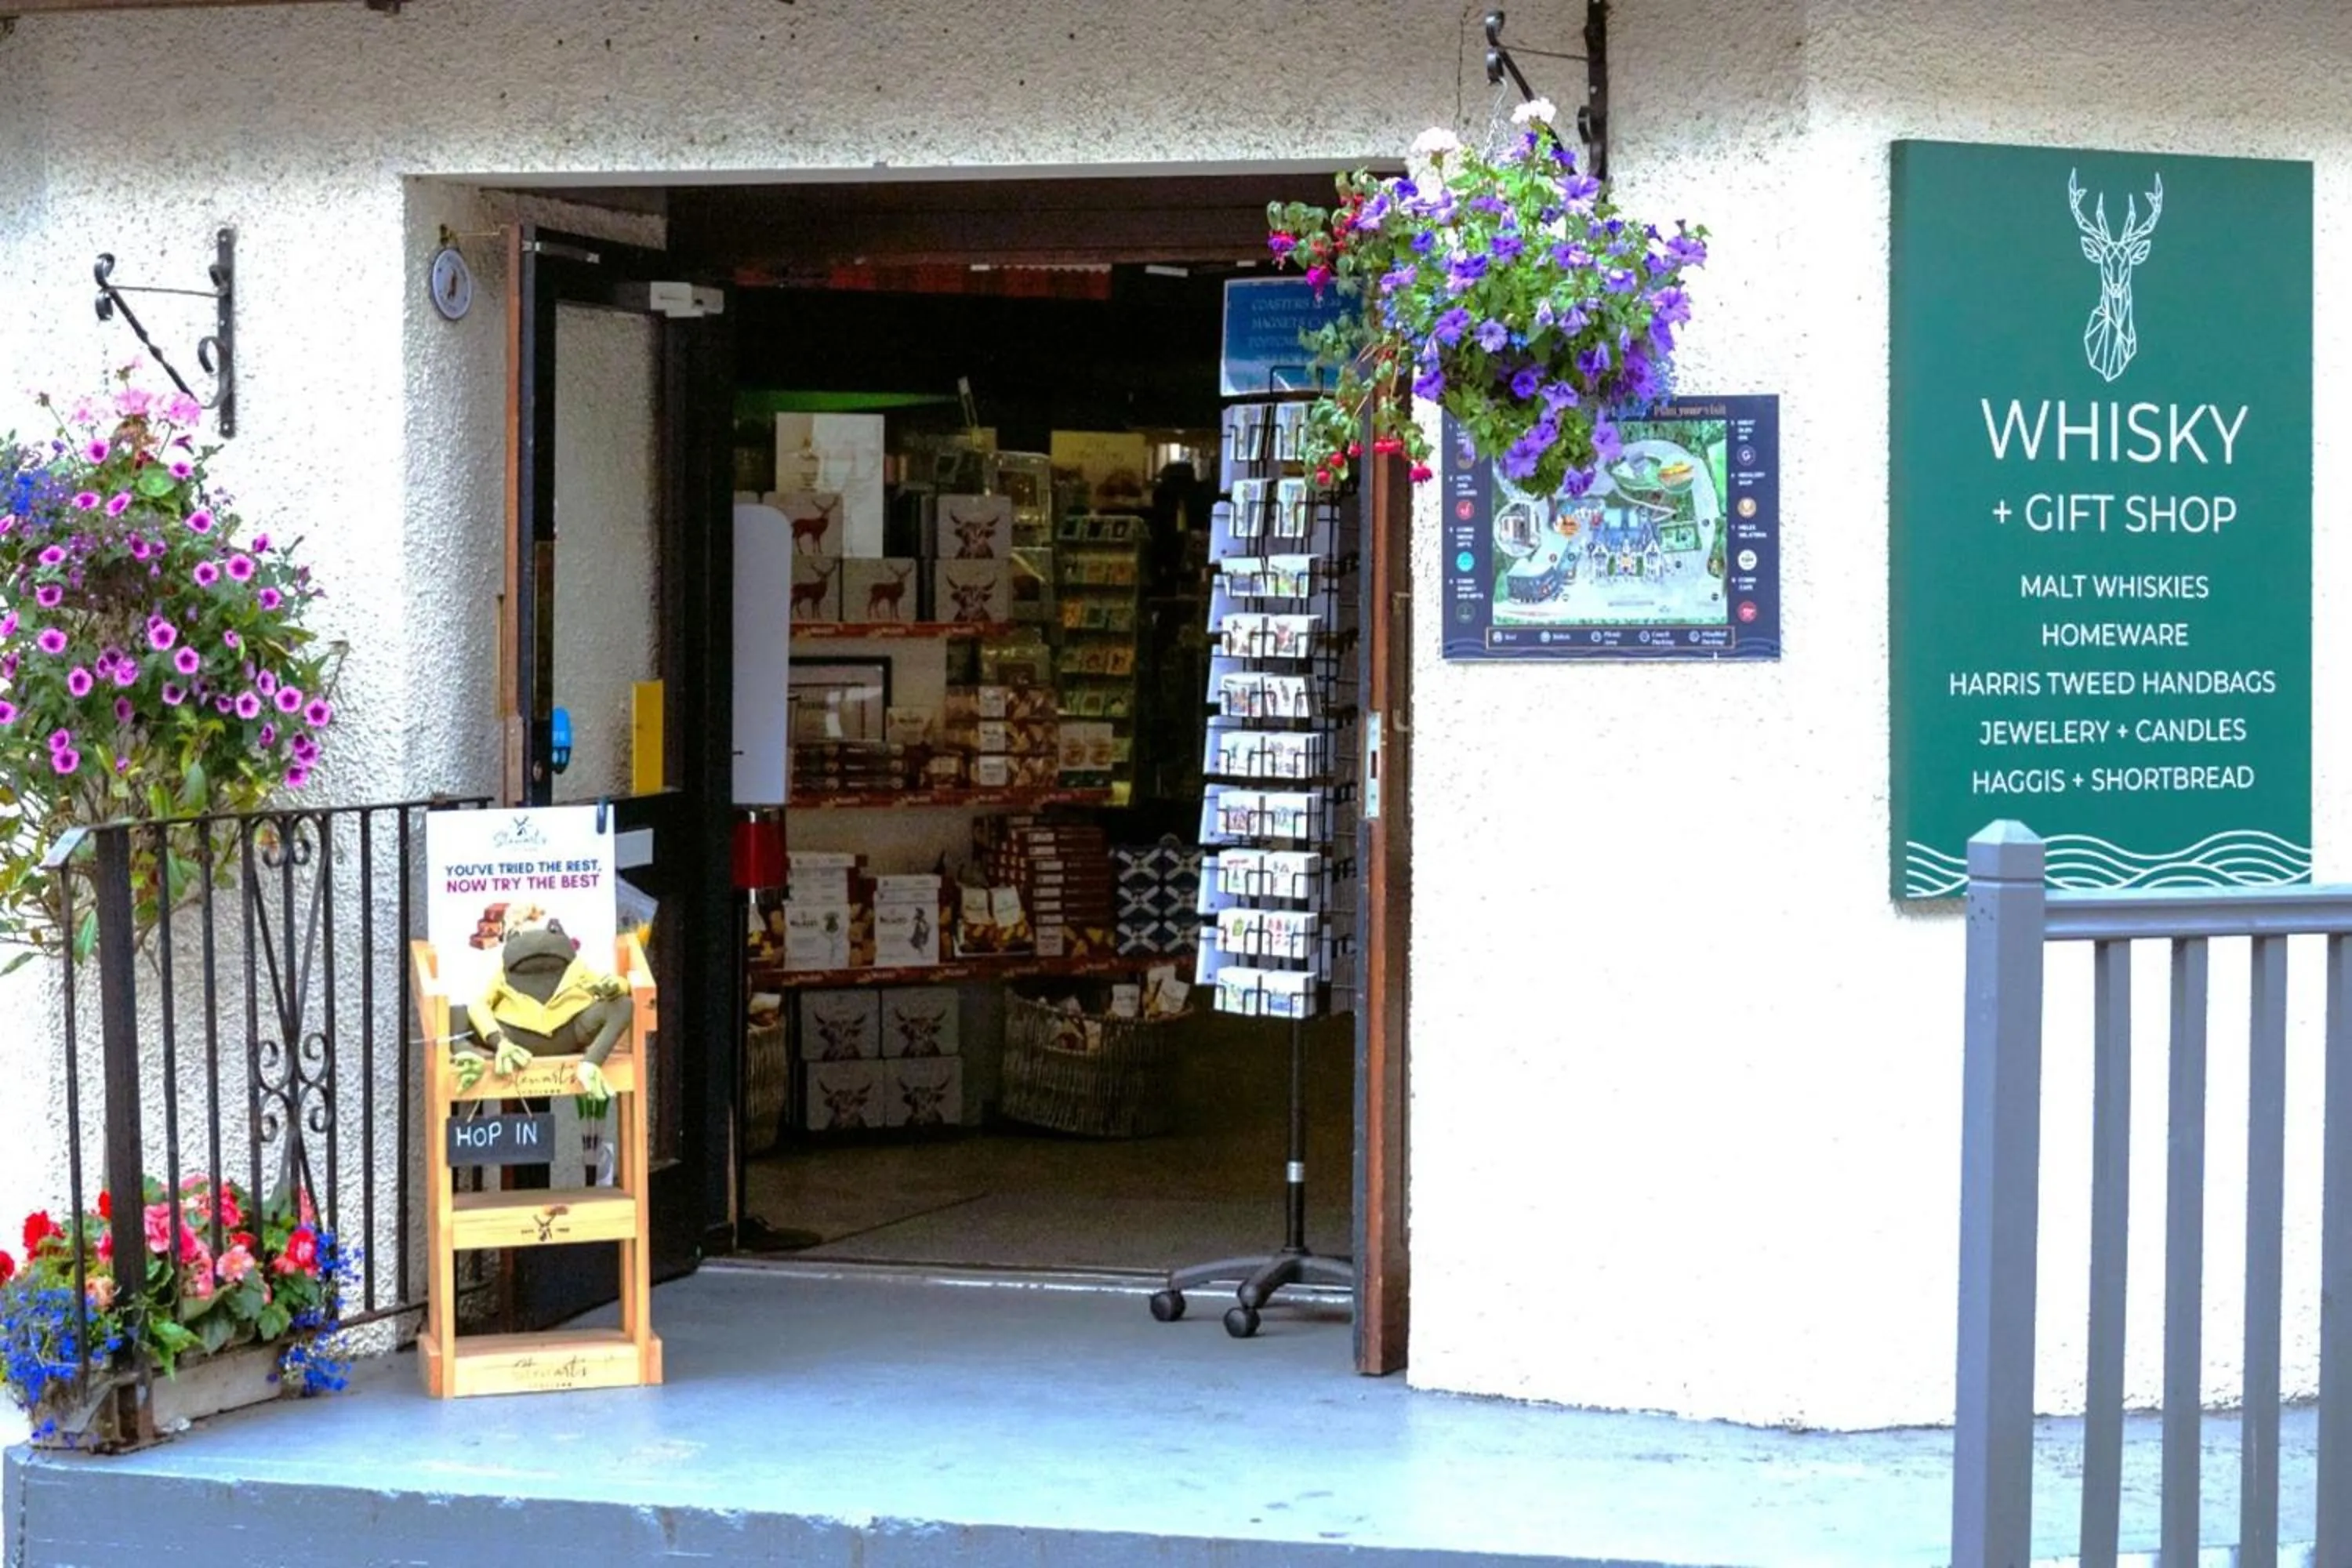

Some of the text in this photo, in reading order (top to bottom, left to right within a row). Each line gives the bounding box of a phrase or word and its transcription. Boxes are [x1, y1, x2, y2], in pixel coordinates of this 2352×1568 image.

[1981, 398, 2248, 464] WHISKY
[1992, 493, 2237, 532] + GIFT SHOP
[2021, 575, 2209, 598] MALT WHISKIES
[2042, 623, 2188, 646] HOMEWARE
[1950, 670, 2275, 695] HARRIS TWEED HANDBAGS
[1980, 718, 2246, 745] JEWELERY + CANDLES
[1973, 766, 2255, 793] HAGGIS + SHORTBREAD
[445, 863, 494, 877] YOU'VE
[499, 862, 535, 874] TRIED
[537, 860, 562, 873] THE
[446, 873, 601, 894] NOW TRY THE BEST
[455, 1121, 538, 1148] HOP IN
